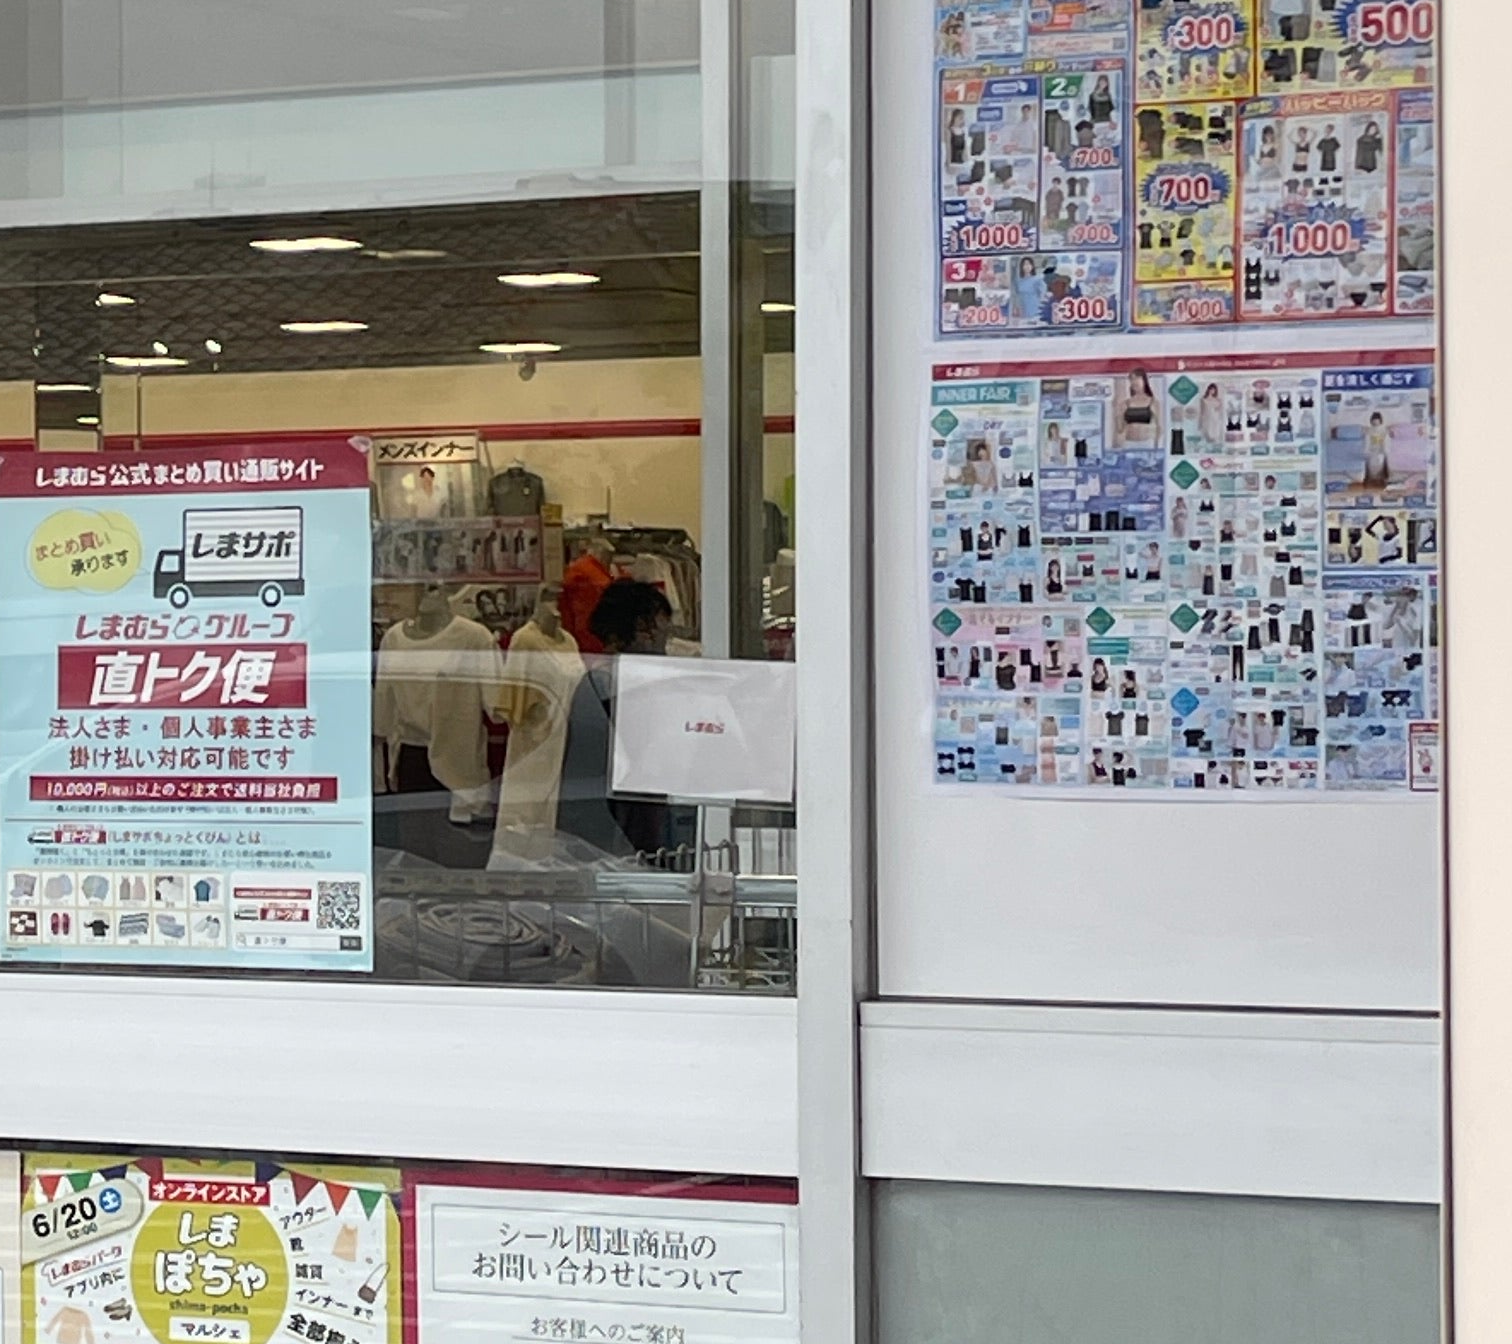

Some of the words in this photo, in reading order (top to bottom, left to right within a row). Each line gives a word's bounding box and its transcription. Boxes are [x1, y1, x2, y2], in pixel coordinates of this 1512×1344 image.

[378, 441, 474, 459] メンズインナー
[36, 457, 325, 488] しまむら公式まとめ買い通販サイト
[35, 532, 111, 561] まとめ買い
[191, 531, 296, 559] しまサポ
[70, 549, 129, 577] 承ります
[75, 612, 296, 641] しまむらグループ
[89, 650, 277, 705] 直トク便
[47, 715, 318, 740] 法人さま・個人事業主さま
[69, 745, 296, 771] 掛け払い対応可能です
[151, 1182, 269, 1204] オンラインストア
[32, 1197, 97, 1238] 6/20
[102, 1190, 120, 1210] 土
[279, 1206, 327, 1230] アウター
[178, 1210, 239, 1249] しま
[498, 1221, 717, 1260] シール関連商品の
[64, 1267, 126, 1298] アプリ内に
[154, 1249, 269, 1298] ぽちゃ
[471, 1252, 745, 1296] お問い合わせについて
[180, 1321, 243, 1341] マルシェ
